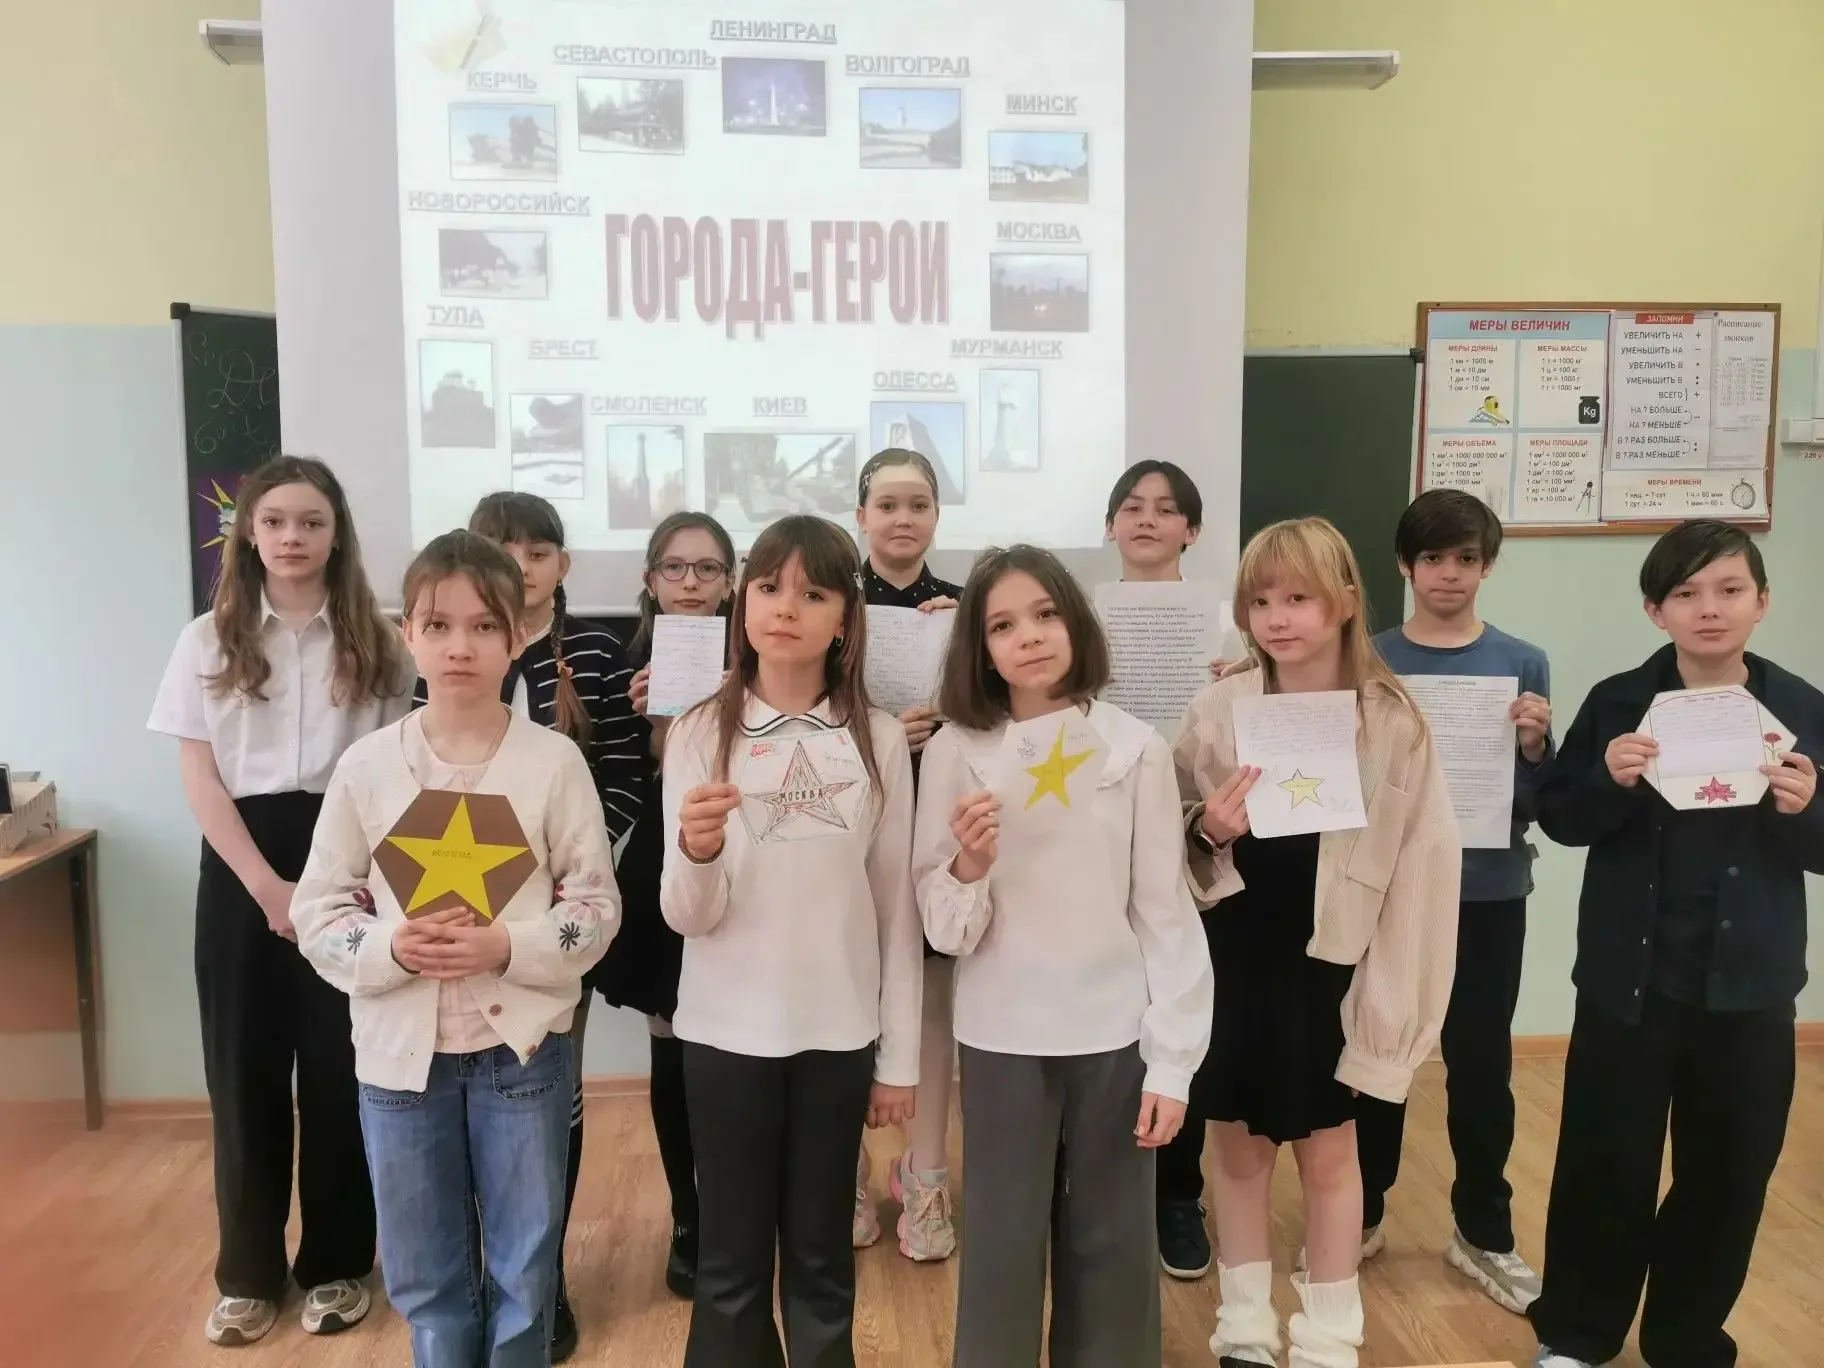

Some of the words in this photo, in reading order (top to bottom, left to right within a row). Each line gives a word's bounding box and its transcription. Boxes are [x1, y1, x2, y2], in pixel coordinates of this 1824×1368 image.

[710, 20, 837, 41] ЛЕНИНГРАД
[553, 44, 717, 66] СЕВАСТОПОЛЬ
[845, 54, 970, 76] ВОЛГОГРАД
[466, 71, 538, 90] КЕРЧЬ
[1006, 94, 1078, 113] МИНСК
[409, 190, 591, 213] НОВОРОССИЙСК
[996, 221, 1082, 240] МОСКВА
[605, 212, 950, 342] ГОРОДА-ГЕРОИ
[426, 305, 485, 326] ТУЛА
[1646, 315, 1684, 323] ЗАПОМНИ
[1469, 320, 1506, 331] МЕРЫ
[1511, 320, 1571, 331] ВЕЛИЧИН
[1624, 331, 1671, 340] УВЕЛИЧИТЬ
[1672, 331, 1684, 340] НА
[528, 339, 599, 357] БРЕСТ
[951, 338, 1063, 357] МУРМАНСК
[1471, 345, 1498, 353] ДЛИНЫ
[1621, 347, 1670, 355] УМЕНЬШИТЬ
[1672, 347, 1683, 355] НА
[1628, 361, 1676, 370] УВЕЛИЧИТЬ
[1678, 361, 1683, 369] В
[872, 370, 958, 390] ОДЕССА
[1625, 376, 1676, 385] УМЕНЬШИТЬ
[1677, 376, 1683, 384] В
[1658, 391, 1683, 399] ВСЕГО
[589, 395, 708, 413] СМОЛЕНСК
[752, 396, 808, 414] КИЕВ
[1583, 406, 1597, 418] Kg
[1630, 405, 1641, 414] НА
[1649, 405, 1683, 414] БОЛЬШЕ
[1629, 420, 1640, 429] НА
[1647, 420, 1682, 429] МЕНЬШЕ
[1617, 436, 1623, 444] В
[1630, 436, 1645, 444] РАЗ
[1647, 435, 1682, 444] БОЛЬШЕ
[1615, 451, 1621, 459] В
[1628, 451, 1643, 459] РАЗ
[1646, 450, 1681, 459] МЕНЬШЕ
[780, 788, 824, 803] МОСКВА
